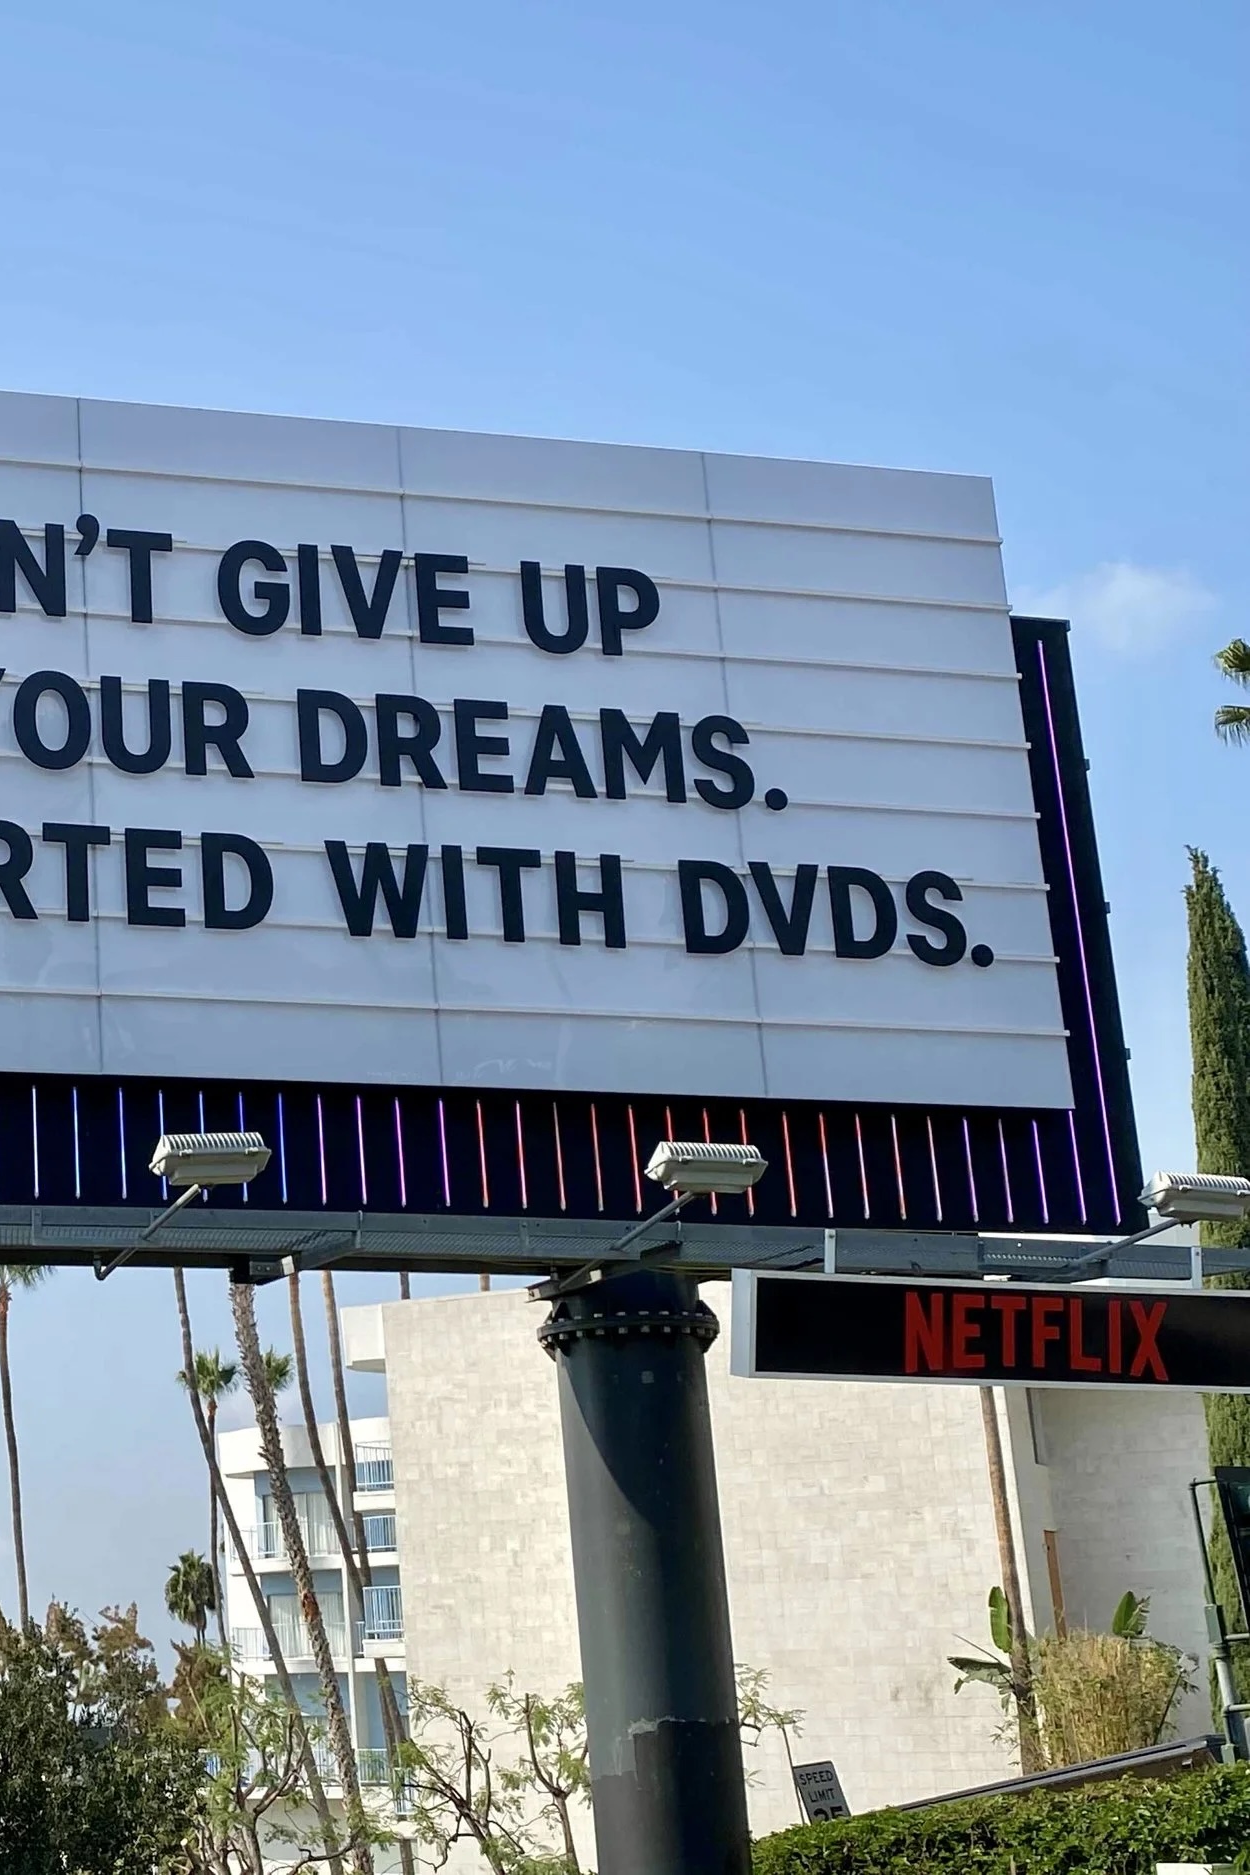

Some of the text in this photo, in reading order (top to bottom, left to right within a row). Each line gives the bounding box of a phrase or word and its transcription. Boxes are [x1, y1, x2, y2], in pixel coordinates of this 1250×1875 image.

[217, 540, 475, 647] GIVE
[520, 560, 660, 657] UP
[296, 688, 788, 812] DREAMS.
[323, 839, 627, 950] WITH
[677, 859, 995, 968] DVDS.
[904, 1291, 1169, 1381] NETFLIX
[799, 1770, 834, 1786] SPEED
[808, 1788, 836, 1803] LIMIT
